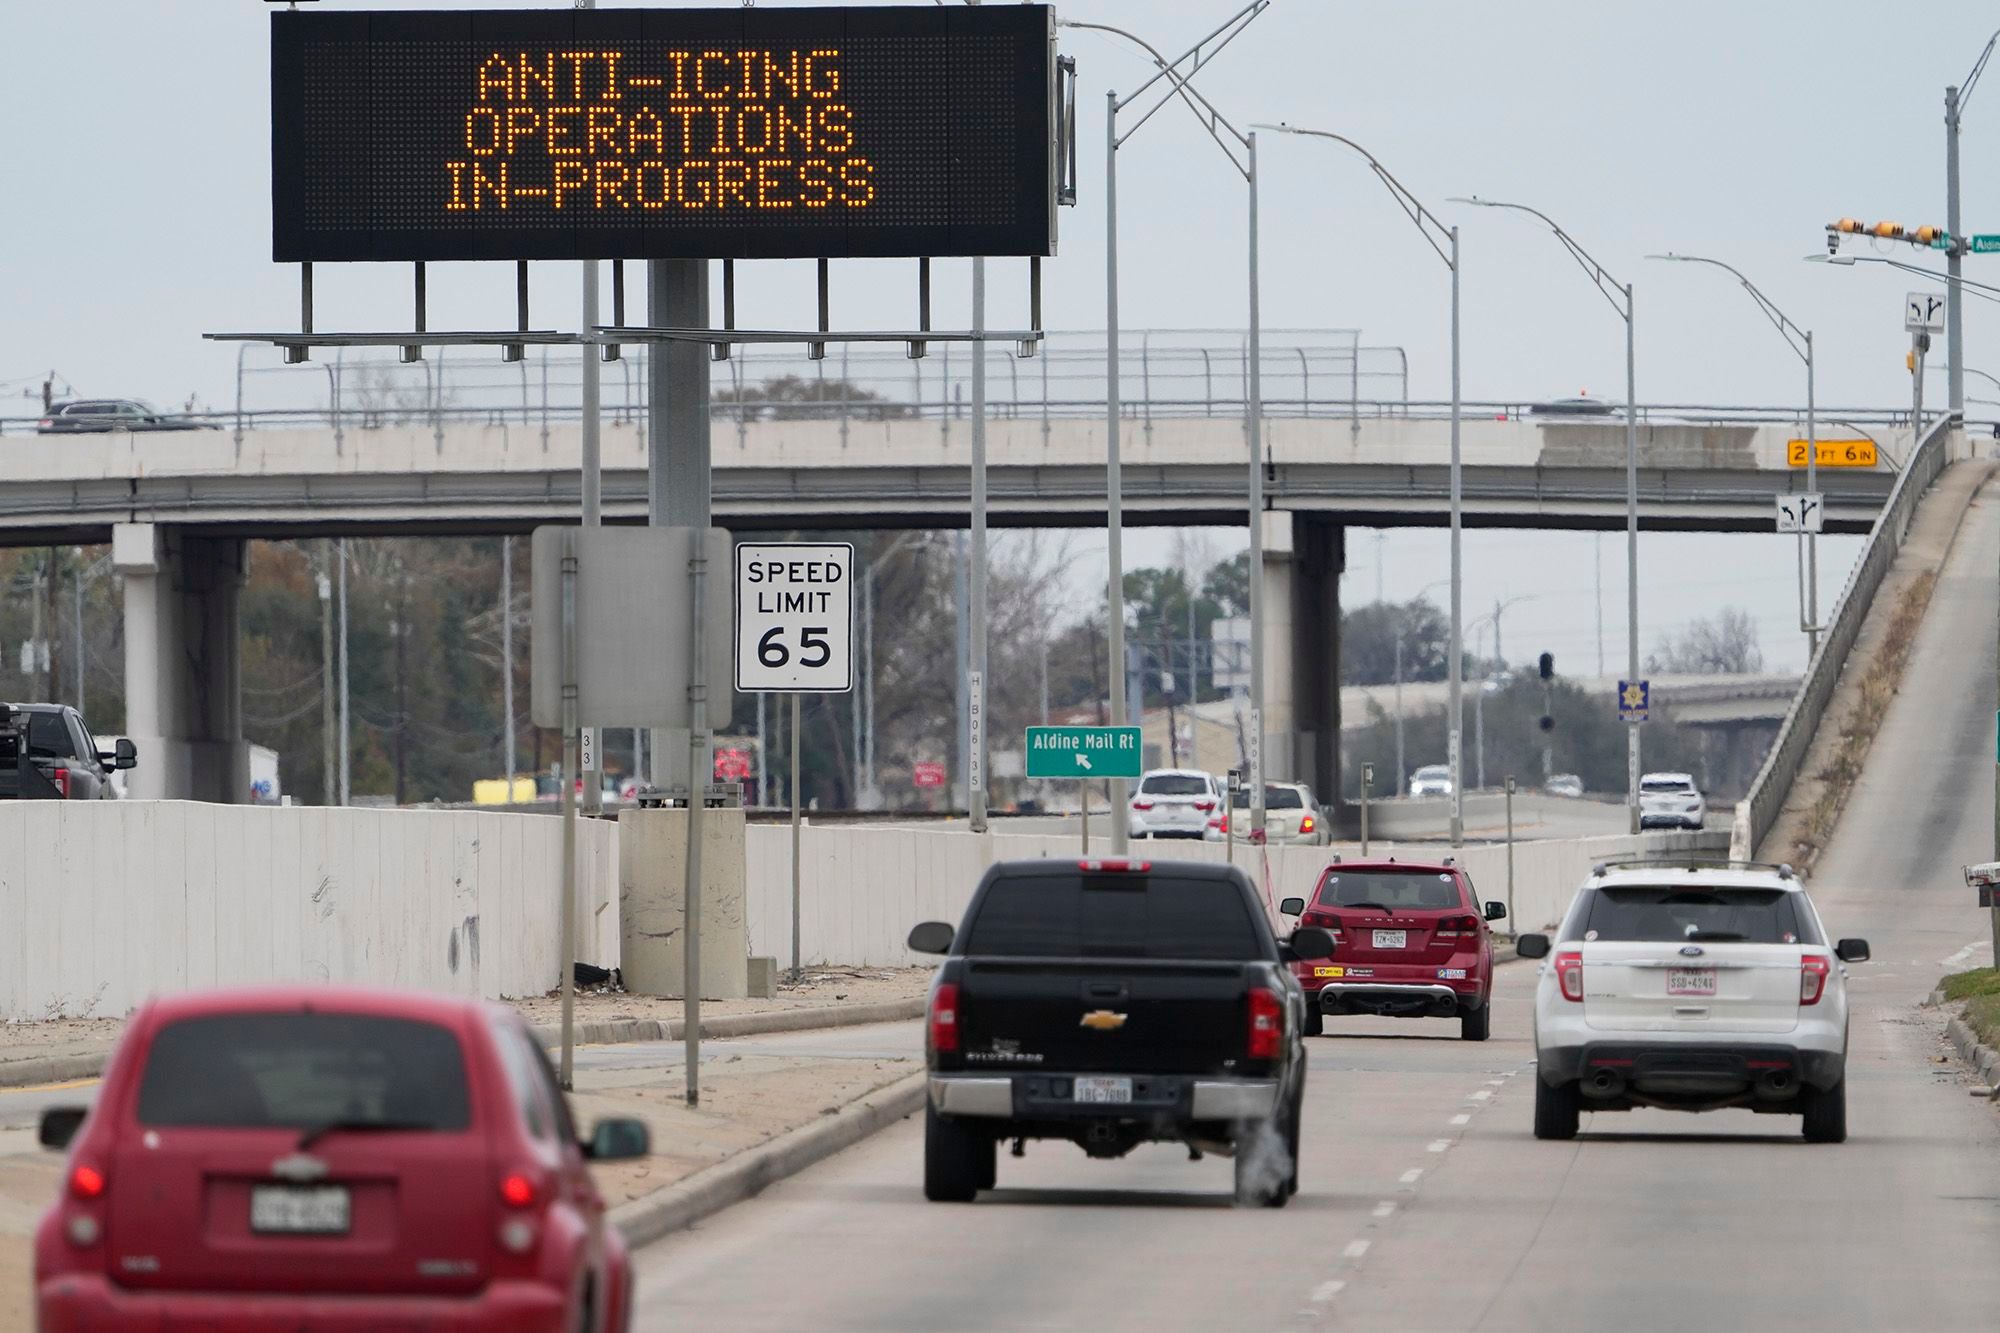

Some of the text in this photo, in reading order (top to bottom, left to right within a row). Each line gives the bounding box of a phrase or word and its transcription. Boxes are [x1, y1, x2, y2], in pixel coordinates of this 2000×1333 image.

[480, 50, 839, 100] ANTI-ICING
[467, 105, 852, 154] OPERATIONS
[447, 159, 874, 209] IN-PROGRESS
[1820, 450, 1836, 460] FT
[1845, 446, 1857, 461] 6
[1860, 451, 1872, 460] IN
[748, 562, 842, 583] SPEED
[758, 592, 831, 613] LIMIT
[757, 627, 831, 668] 65
[1033, 733, 1134, 750] Aldine Mail Rt
